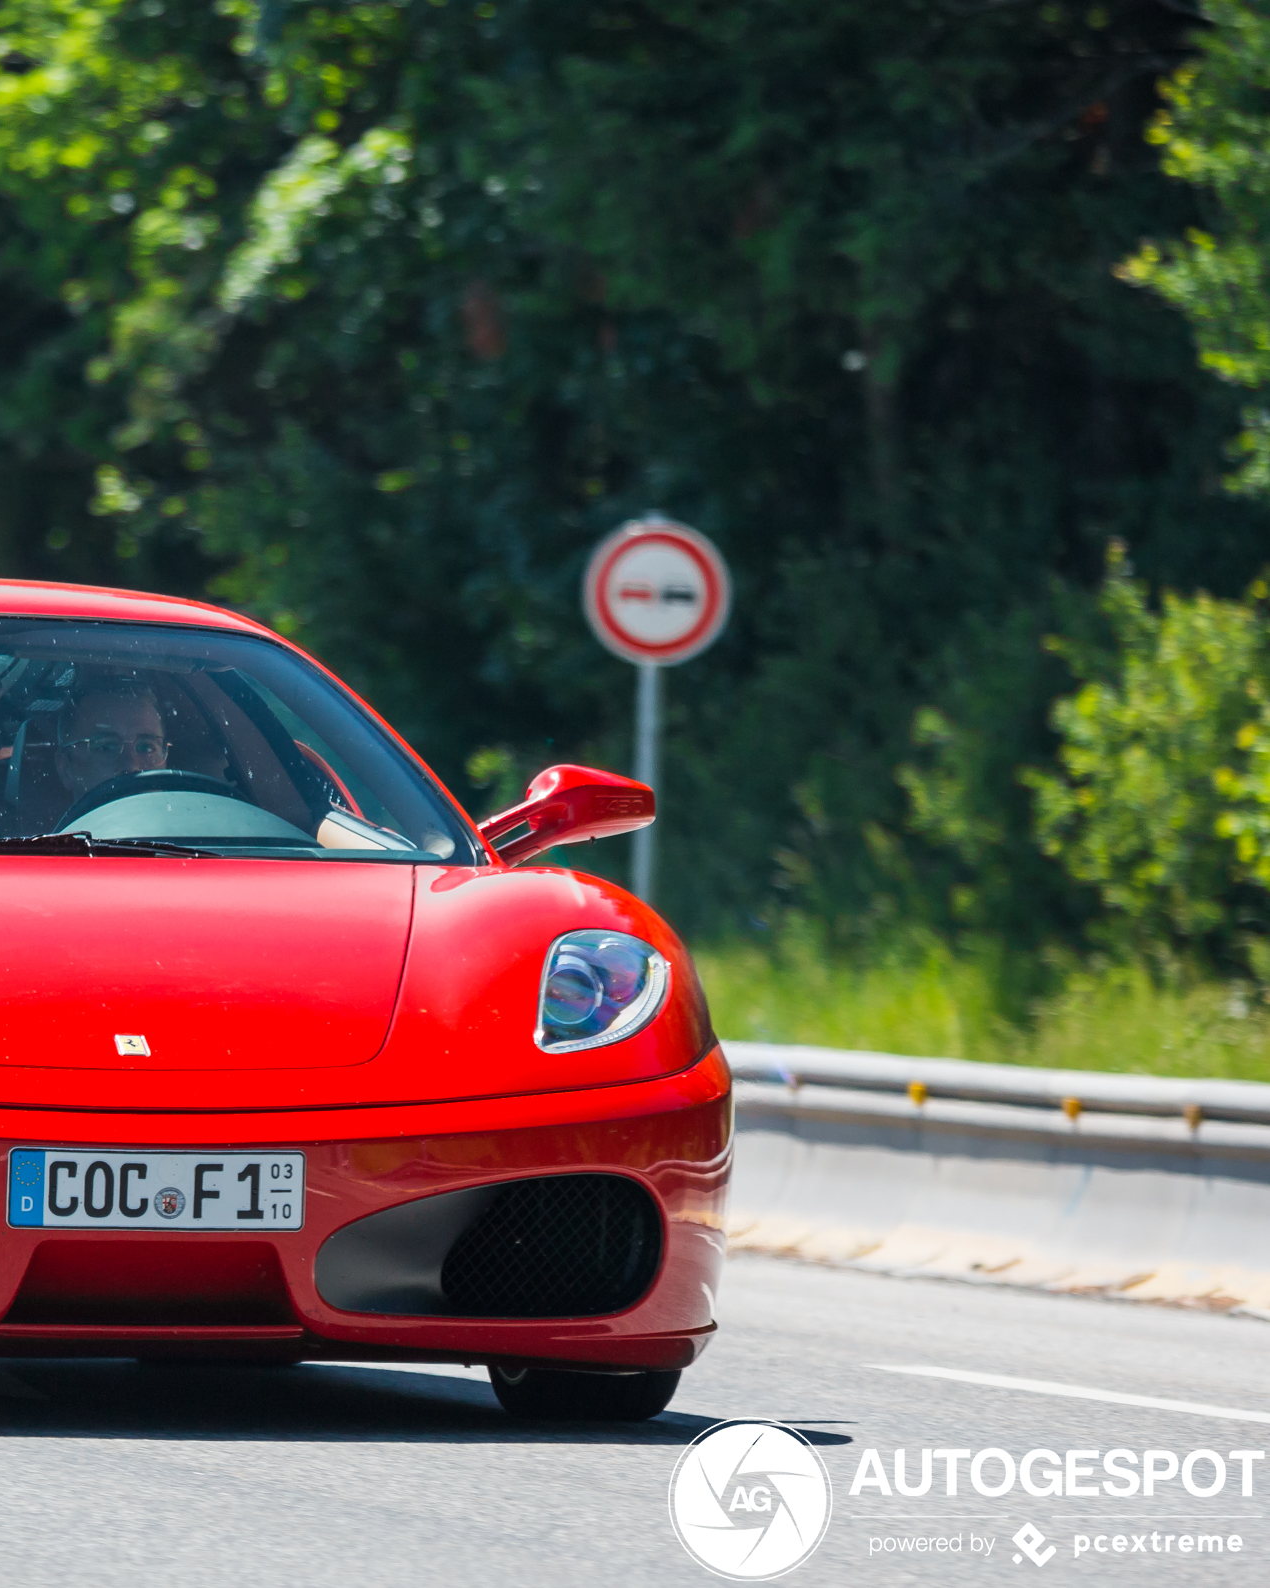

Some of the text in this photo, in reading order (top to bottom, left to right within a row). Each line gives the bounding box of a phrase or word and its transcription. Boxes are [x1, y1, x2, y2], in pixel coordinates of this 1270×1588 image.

[270, 1163, 293, 1179] 03
[48, 1160, 148, 1218] COC
[21, 1195, 34, 1212] D
[271, 1203, 292, 1219] 10
